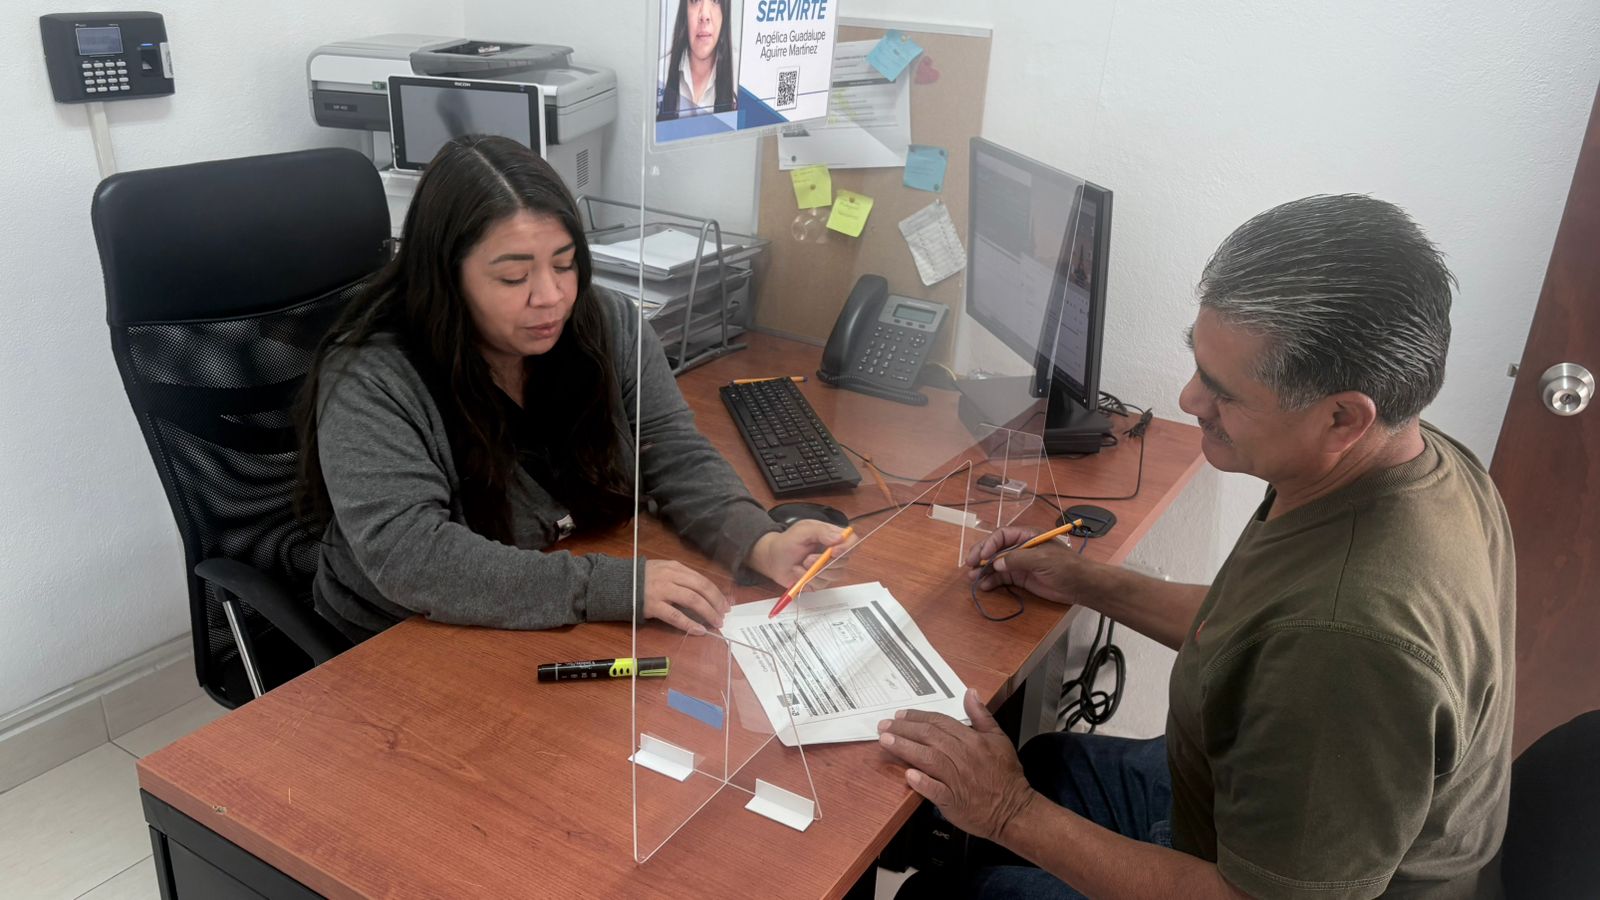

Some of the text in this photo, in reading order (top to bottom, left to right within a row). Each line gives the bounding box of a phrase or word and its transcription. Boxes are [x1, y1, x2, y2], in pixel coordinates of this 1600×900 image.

[756, 0, 827, 22] SERVIRTE
[756, 29, 826, 47] Angélica Guadalupe
[760, 43, 818, 61] Aguirre Martínez
